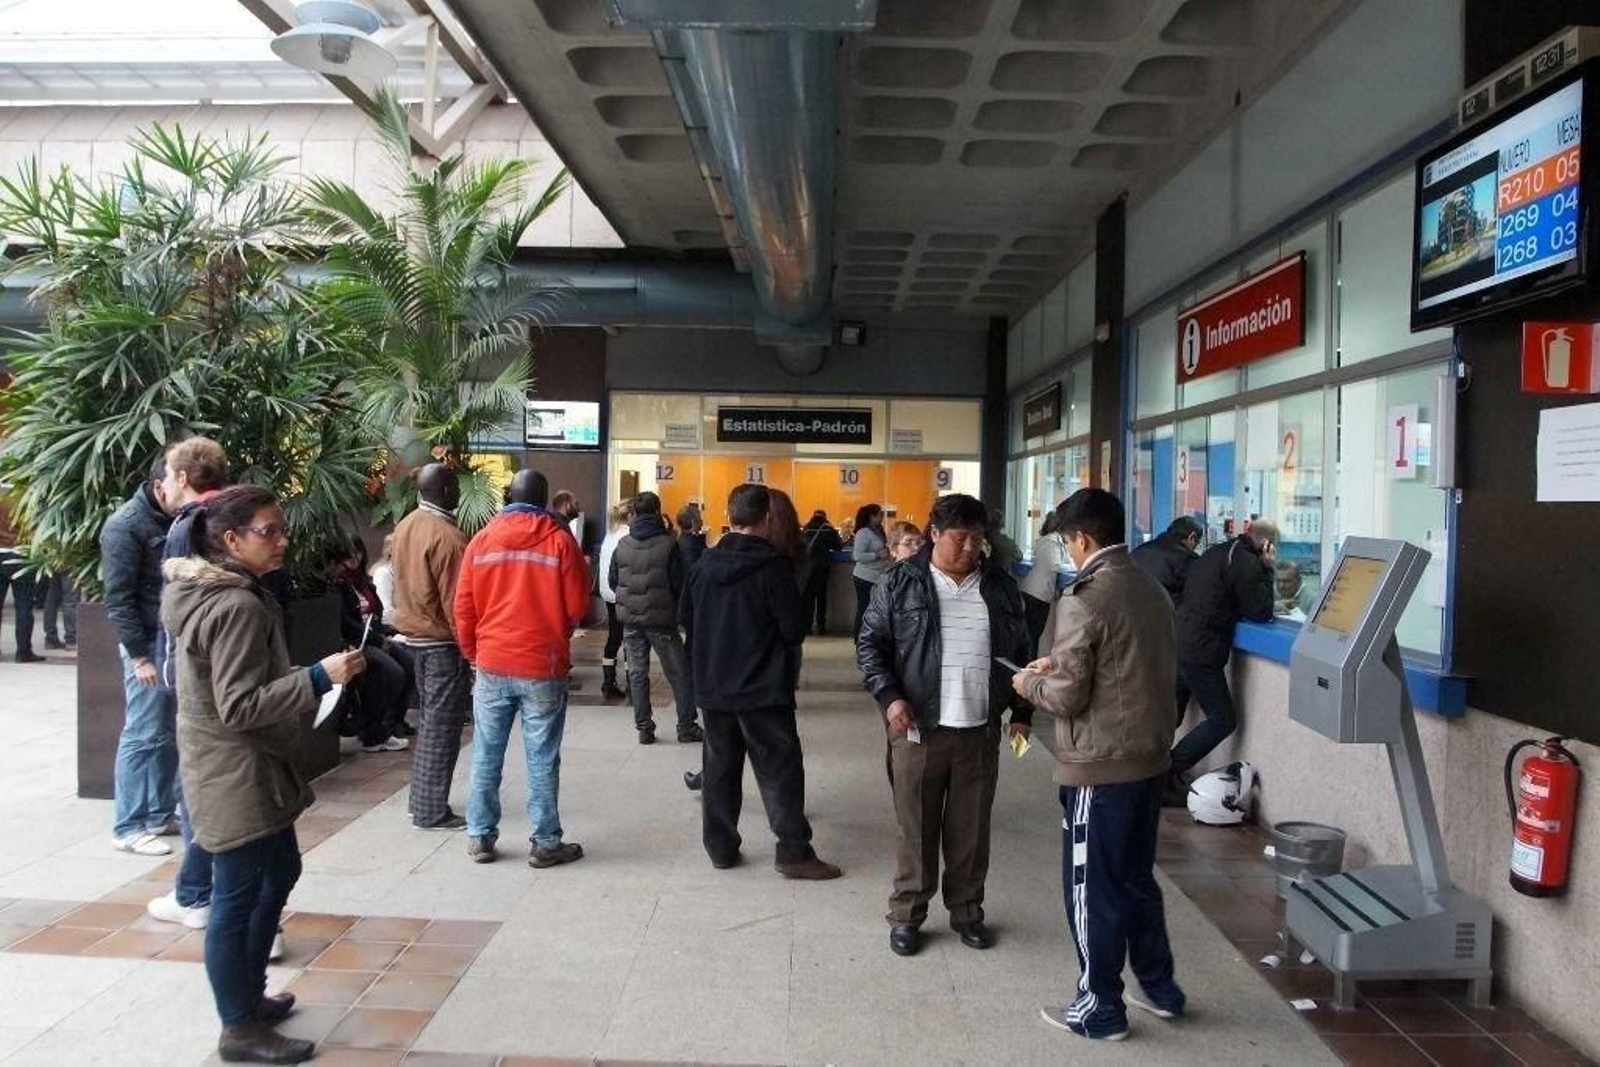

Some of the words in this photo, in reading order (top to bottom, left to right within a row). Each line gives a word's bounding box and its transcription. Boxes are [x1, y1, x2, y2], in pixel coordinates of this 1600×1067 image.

[1499, 168, 1545, 208] R210
[1556, 151, 1580, 183] 05
[1552, 187, 1579, 218] 04
[1551, 221, 1577, 250] 03
[1205, 293, 1292, 351] Información
[1283, 431, 1296, 470] 2
[1395, 415, 1409, 468] 1
[656, 465, 674, 480] 12
[747, 466, 764, 483] 11
[840, 469, 859, 485] 10
[936, 470, 949, 488] 9
[1179, 450, 1187, 484] 3
